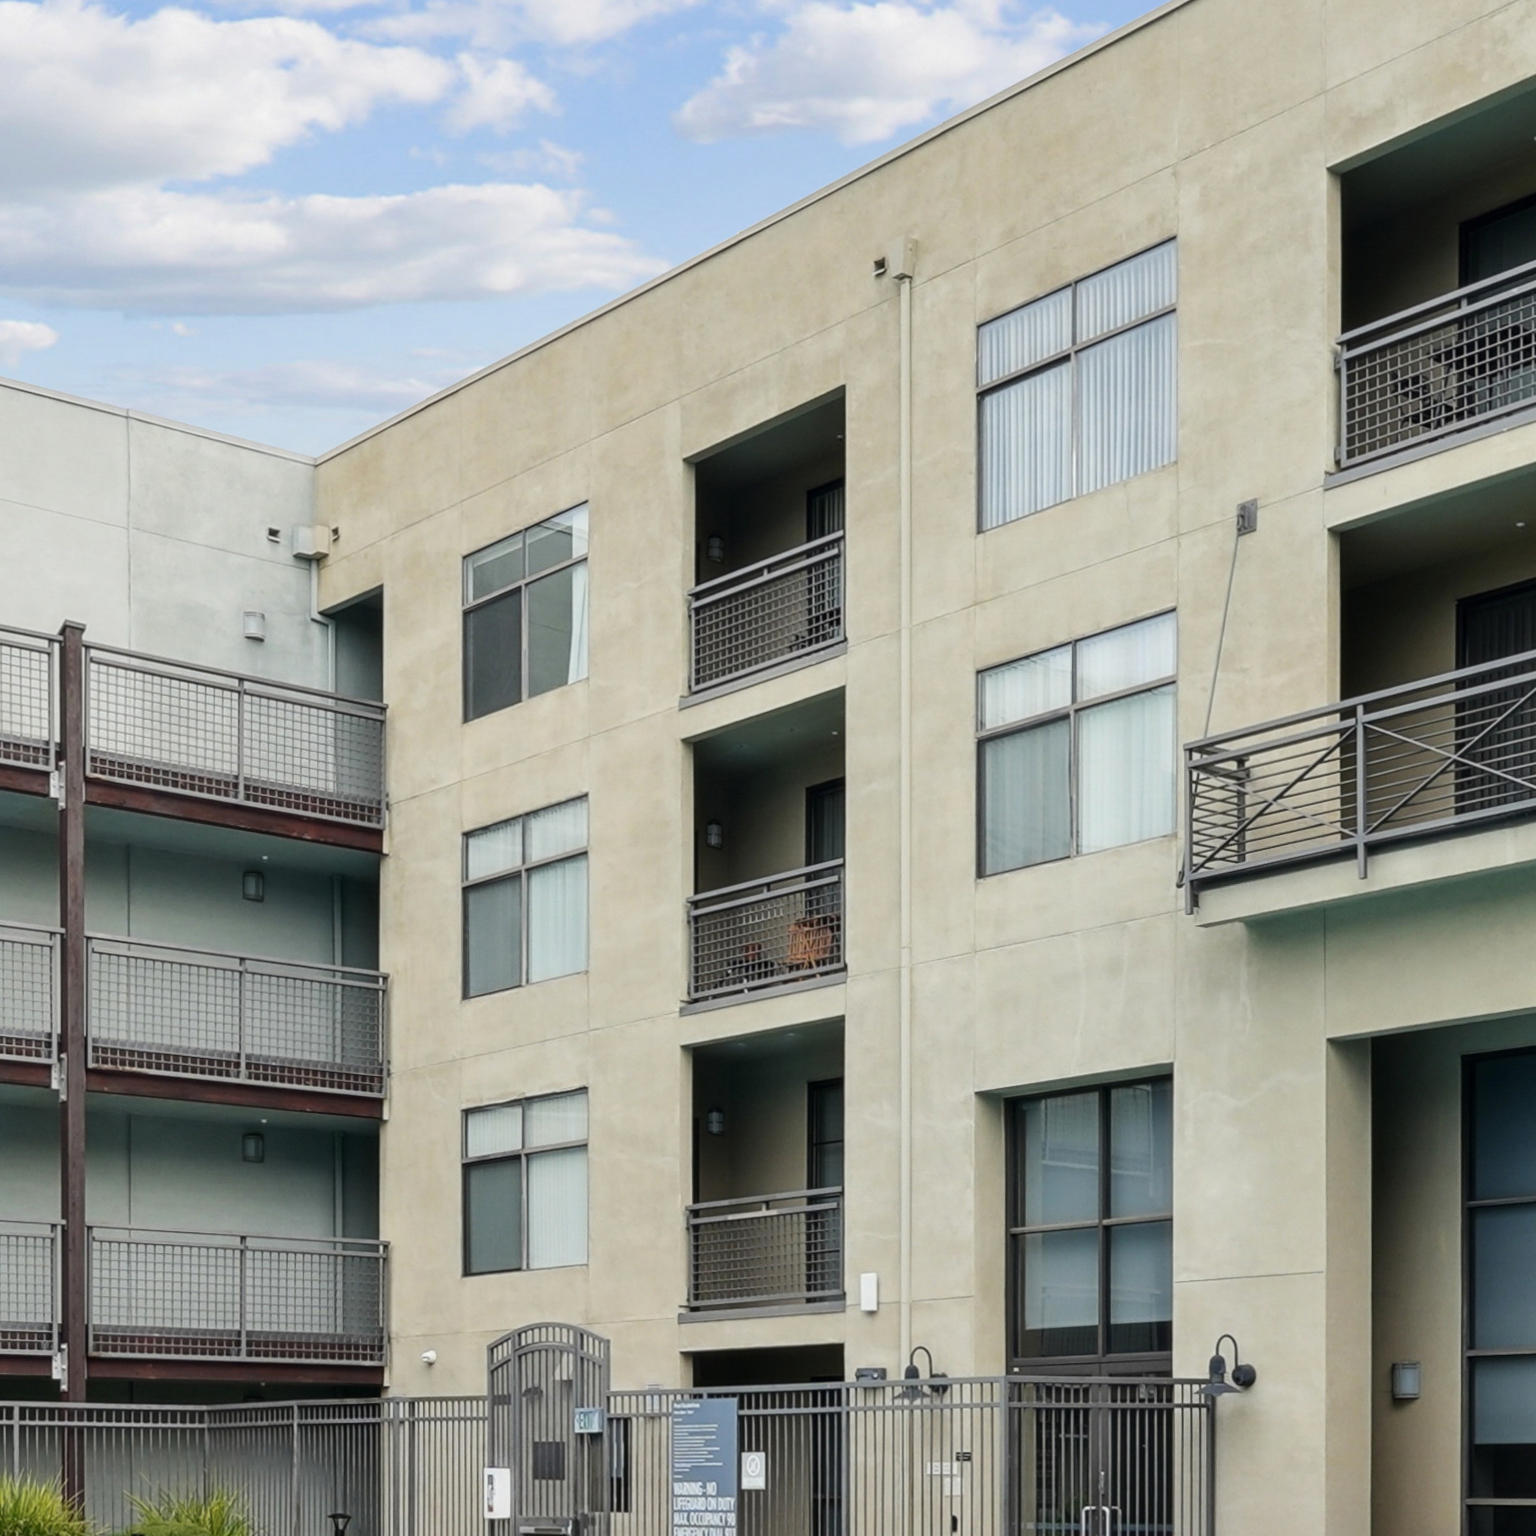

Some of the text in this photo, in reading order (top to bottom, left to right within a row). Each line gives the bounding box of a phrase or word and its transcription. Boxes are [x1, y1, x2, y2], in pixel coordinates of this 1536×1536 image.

[673, 1496, 736, 1511] LIFEGUARD ON DUTY
[689, 1511, 726, 1527] OCCUPANCY
